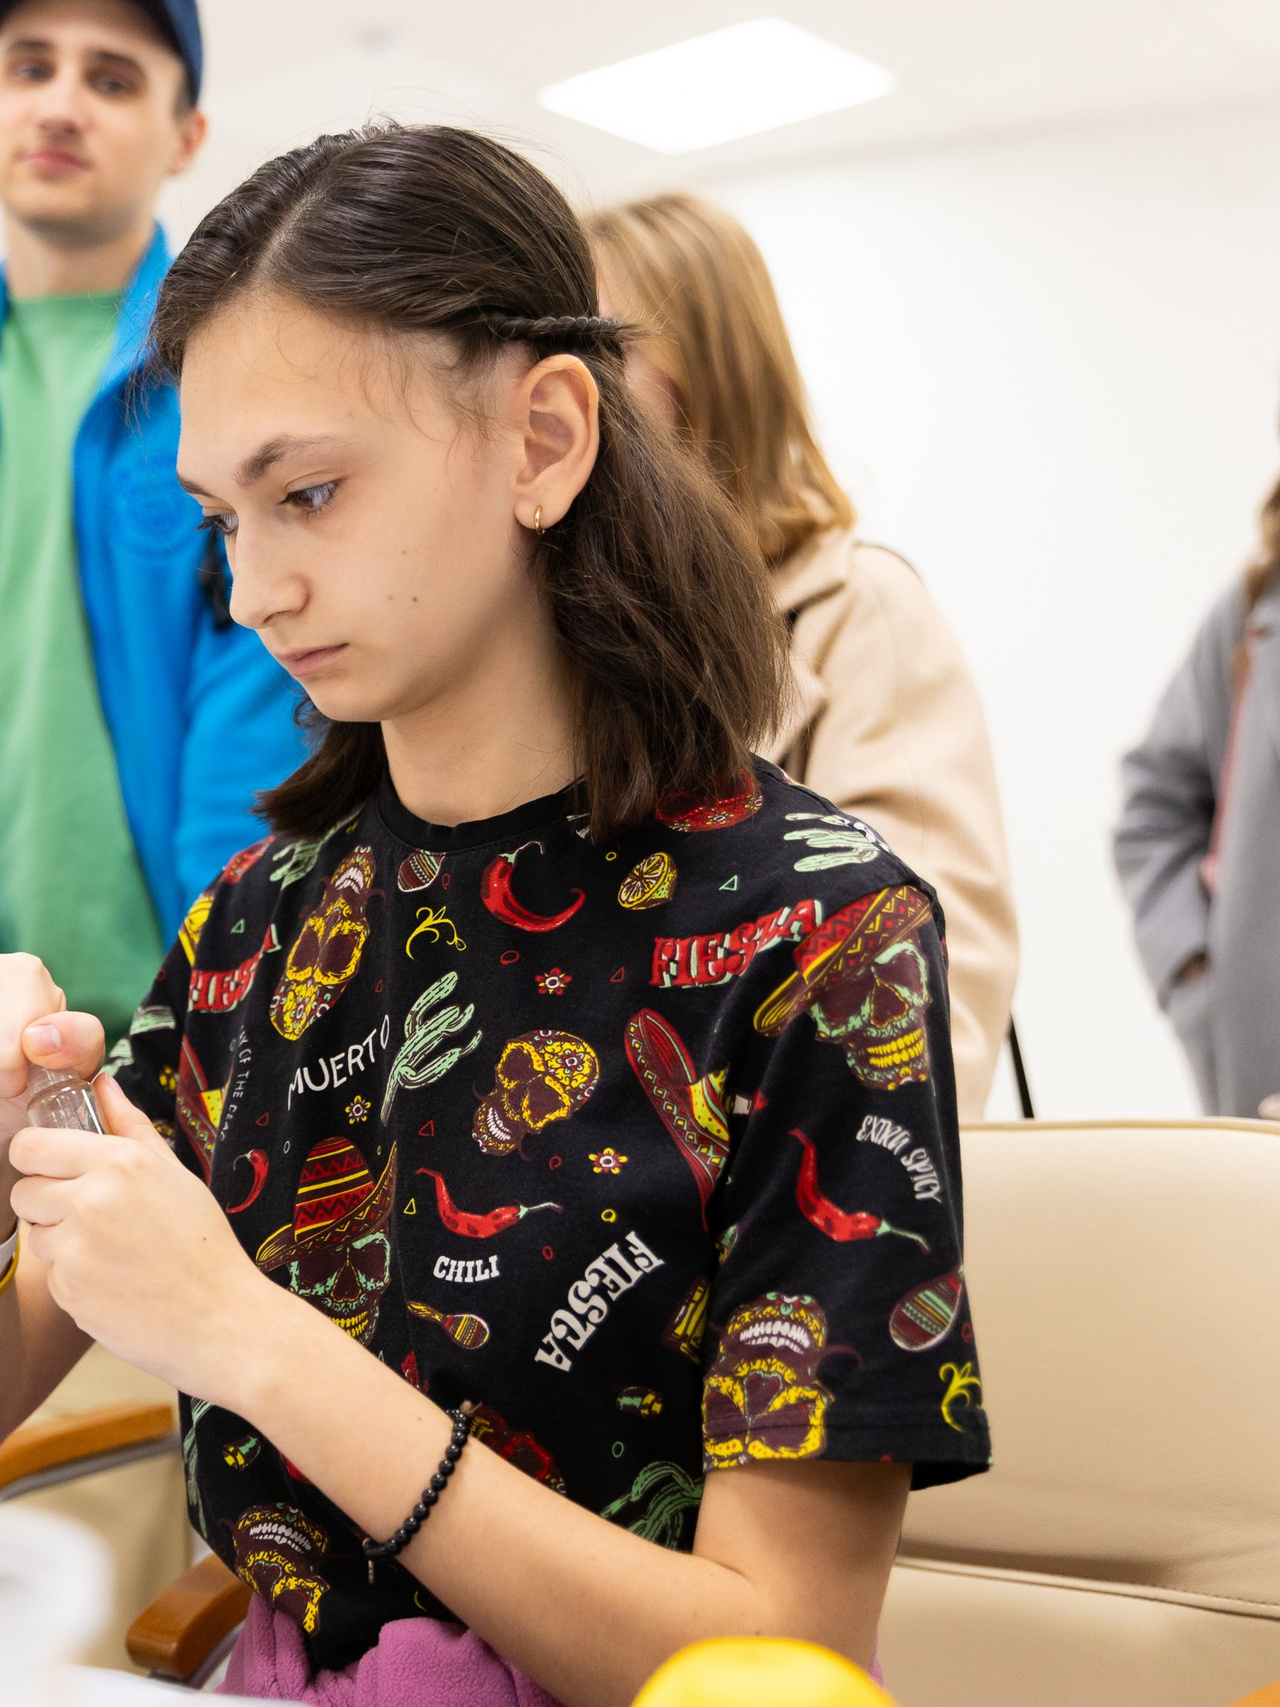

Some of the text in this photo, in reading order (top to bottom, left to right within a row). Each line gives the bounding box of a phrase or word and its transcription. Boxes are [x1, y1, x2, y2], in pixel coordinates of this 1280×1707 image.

[649, 899, 822, 989] FIESTA
[232, 1071, 250, 1098] THE
[287, 1014, 390, 1111] MUERTO
[433, 1255, 500, 1283] CHILI
[534, 1230, 665, 1372] FIESTA
